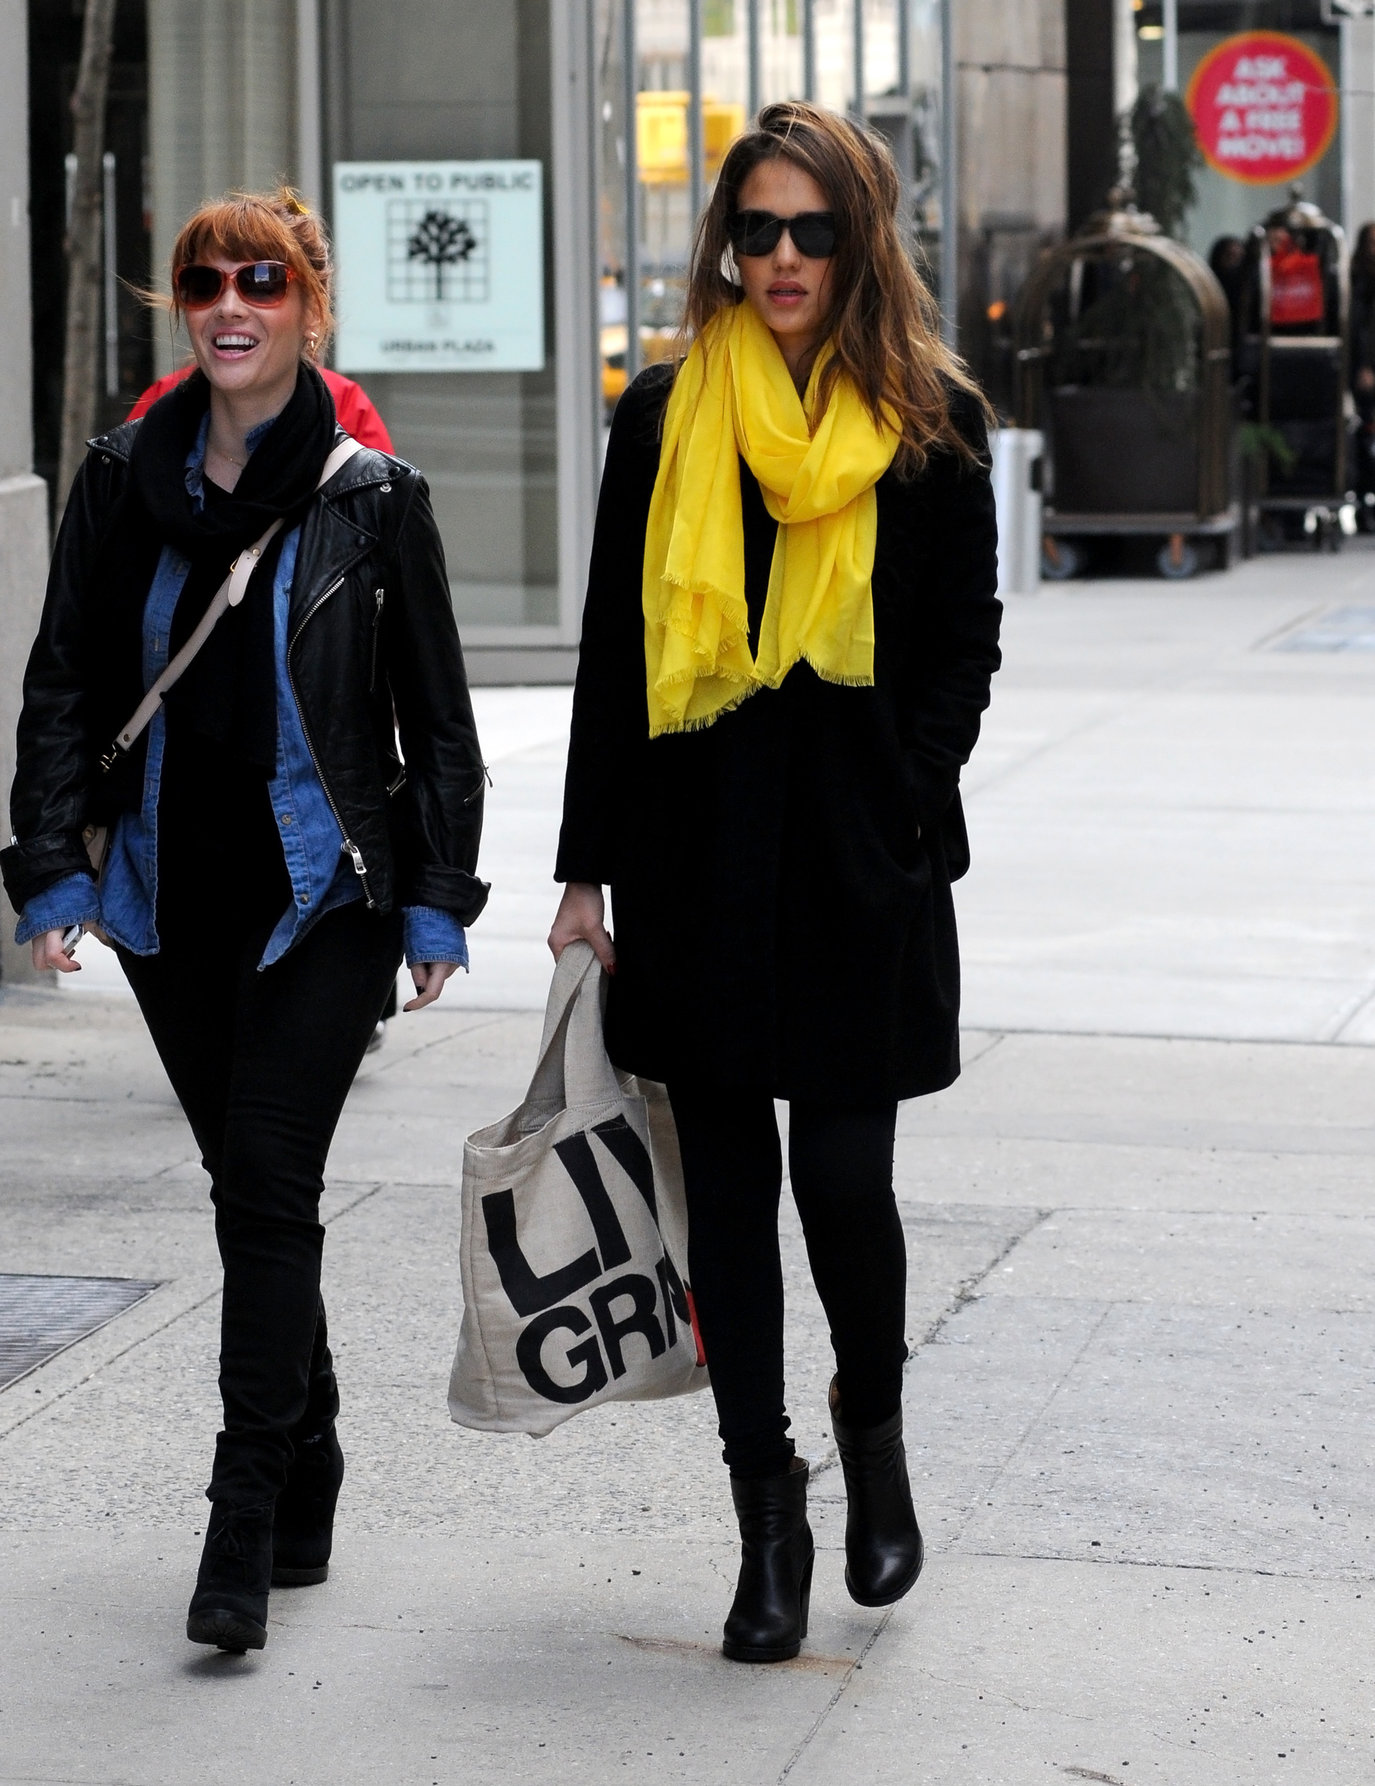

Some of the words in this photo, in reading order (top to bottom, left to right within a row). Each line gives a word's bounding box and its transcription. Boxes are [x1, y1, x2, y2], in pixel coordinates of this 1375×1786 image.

[1233, 55, 1288, 79] ASK
[1215, 80, 1306, 107] ABOUT
[1218, 109, 1241, 131] A
[1244, 108, 1301, 131] FREE
[1215, 134, 1306, 160] MOVE!
[339, 173, 404, 192] OPEN
[413, 172, 443, 192] TO
[450, 171, 534, 191] PUBLIC
[380, 339, 437, 352] URBAN
[442, 338, 496, 352] PLAZA
